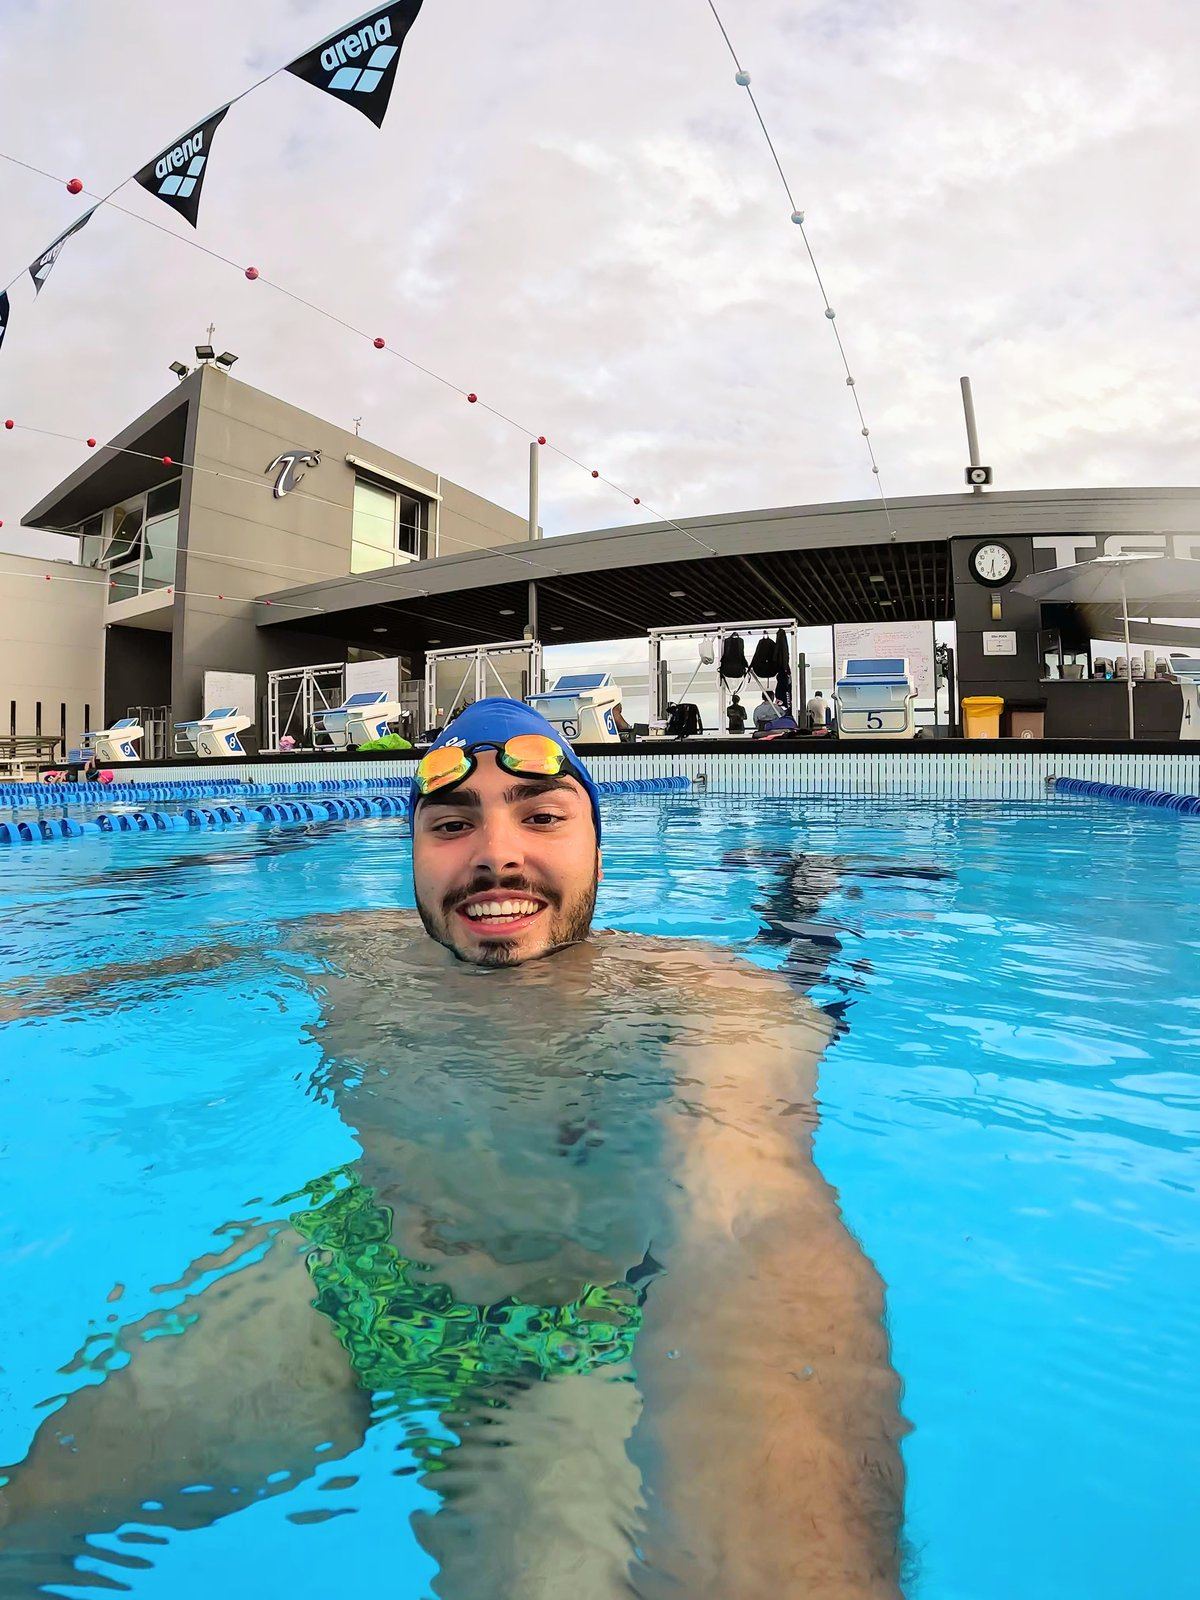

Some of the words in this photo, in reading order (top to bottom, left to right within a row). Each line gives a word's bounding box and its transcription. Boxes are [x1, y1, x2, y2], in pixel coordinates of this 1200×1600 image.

[320, 16, 392, 71] arena
[155, 130, 203, 179] arena
[867, 711, 883, 729] 5
[1185, 699, 1191, 725] 4
[561, 720, 577, 737] 6
[606, 714, 613, 731] 6
[380, 726, 387, 737] 7
[124, 745, 131, 755] 9
[201, 742, 212, 755] 8
[229, 736, 236, 748] 8
[101, 749, 111, 760] 9
